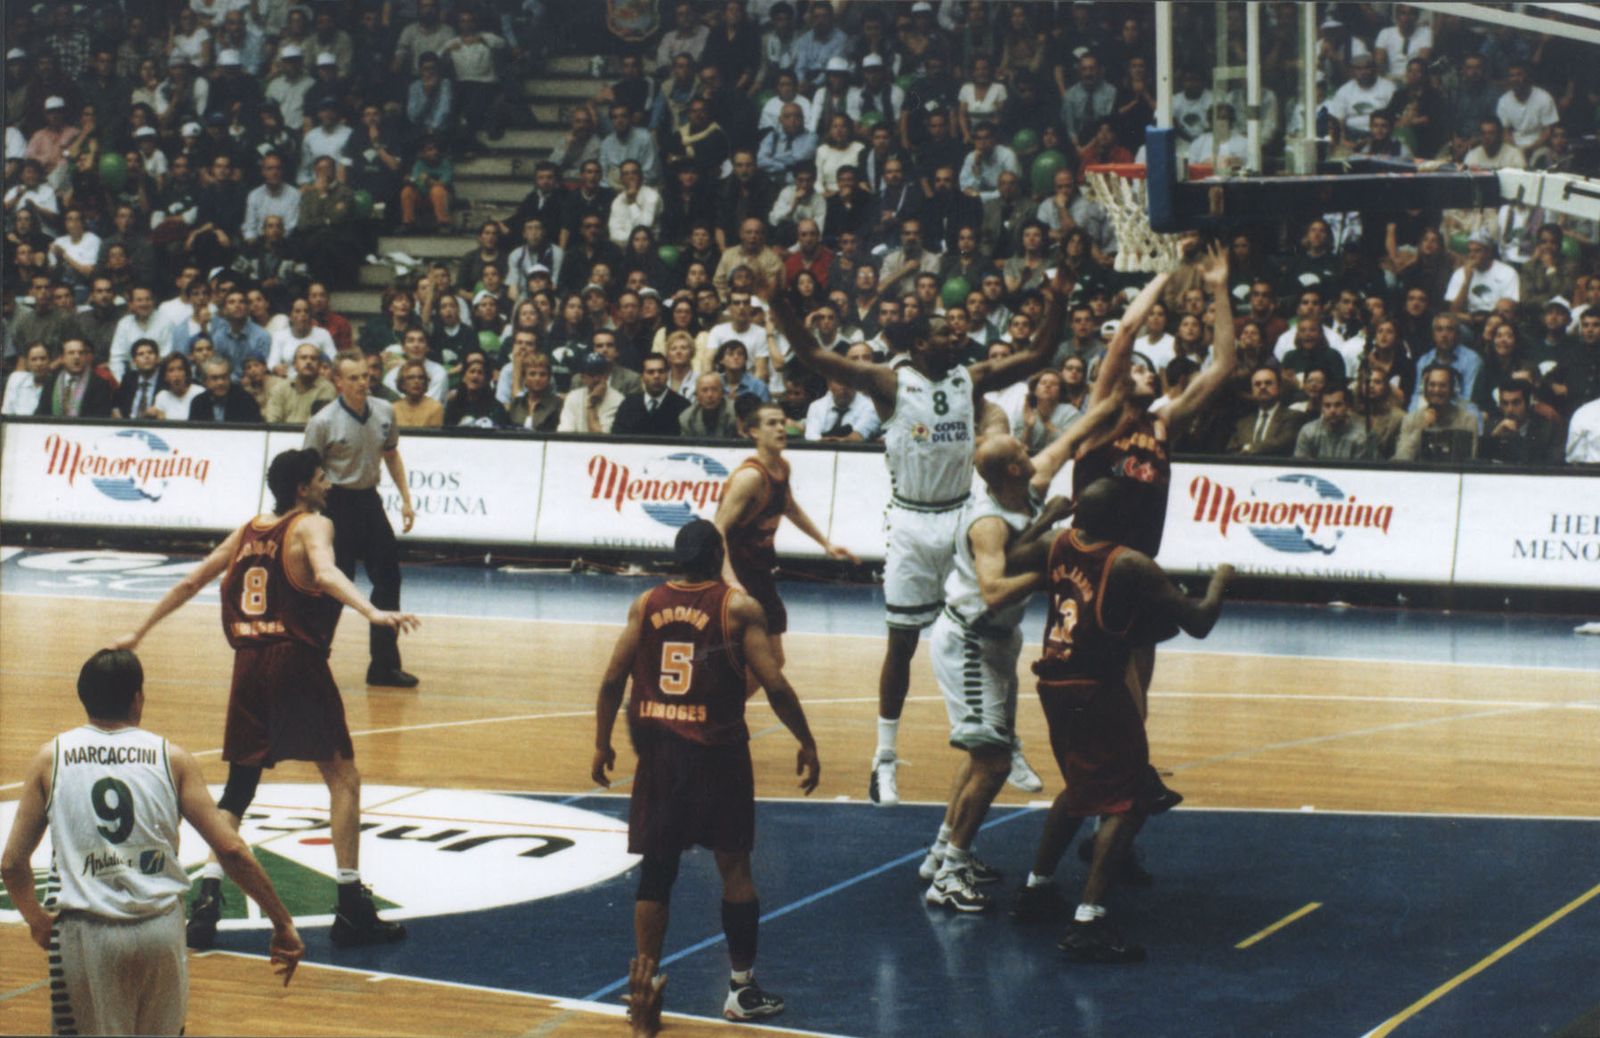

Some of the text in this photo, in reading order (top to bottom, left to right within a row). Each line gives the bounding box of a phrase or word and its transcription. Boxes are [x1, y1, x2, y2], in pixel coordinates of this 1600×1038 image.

[932, 390, 949, 416] 8
[44, 433, 210, 487] Menorquina
[1190, 475, 1394, 538] Menorquina
[240, 567, 268, 616] 8
[659, 641, 695, 695] 5
[639, 700, 707, 722] LIMOGES
[64, 746, 157, 766] MARCACCINI
[91, 776, 135, 845] 9
